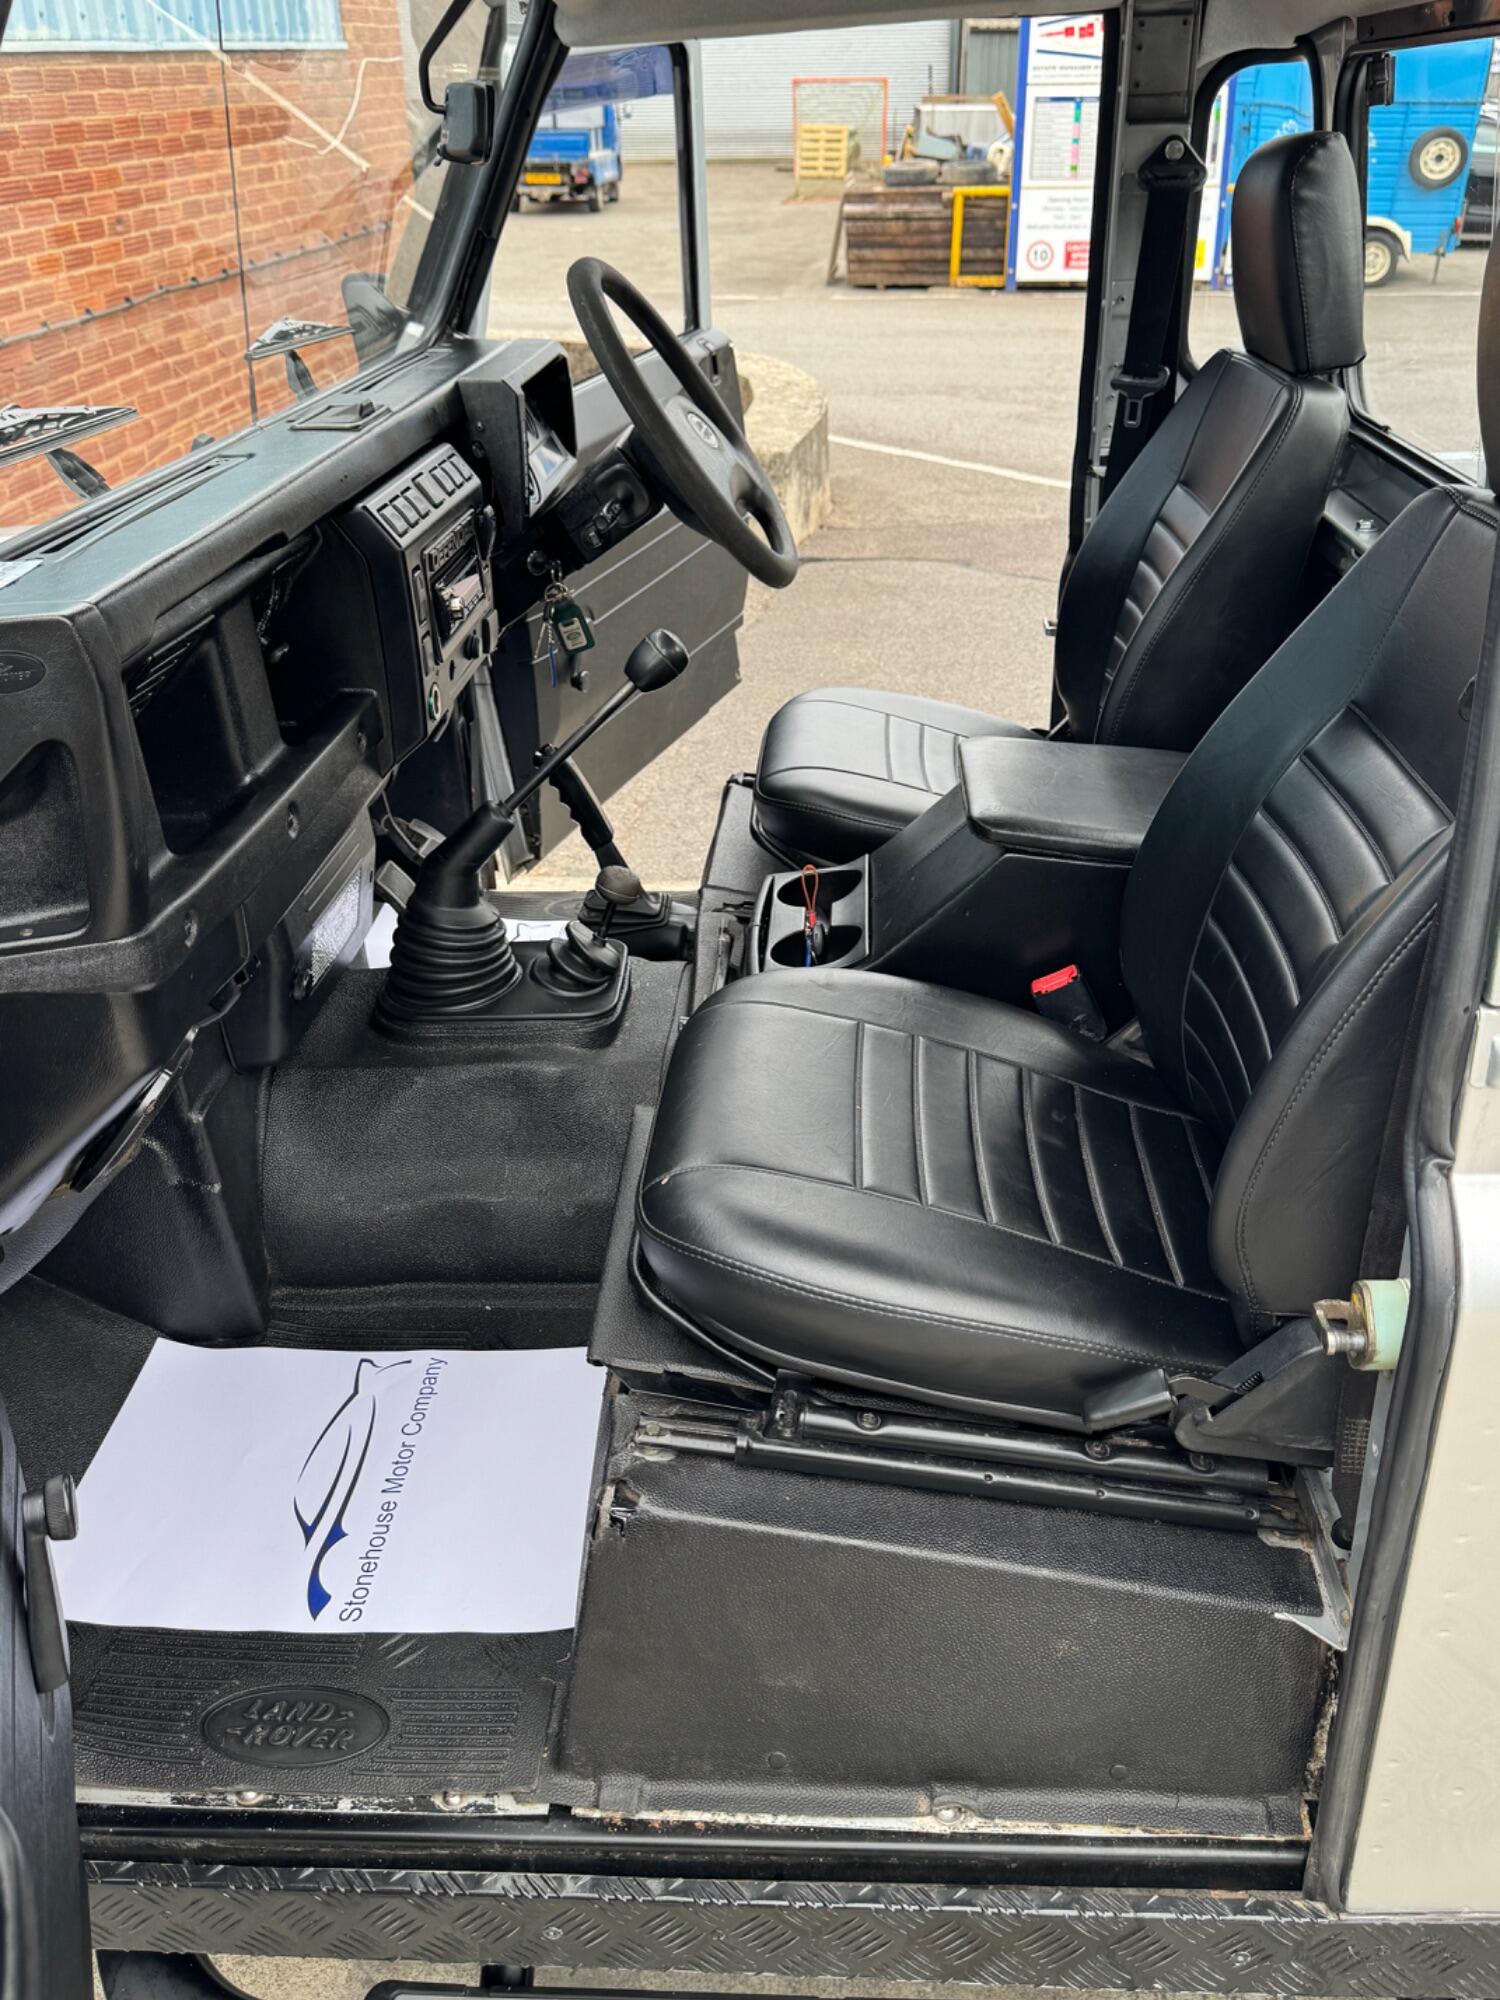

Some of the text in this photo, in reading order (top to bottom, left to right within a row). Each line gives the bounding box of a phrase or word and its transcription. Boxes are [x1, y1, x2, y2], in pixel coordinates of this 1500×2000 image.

[1033, 248, 1049, 262] 10
[338, 1357, 448, 1622] Stonehouse Motor Company
[243, 1699, 335, 1721] LAND
[244, 1723, 355, 1750] ROVER
